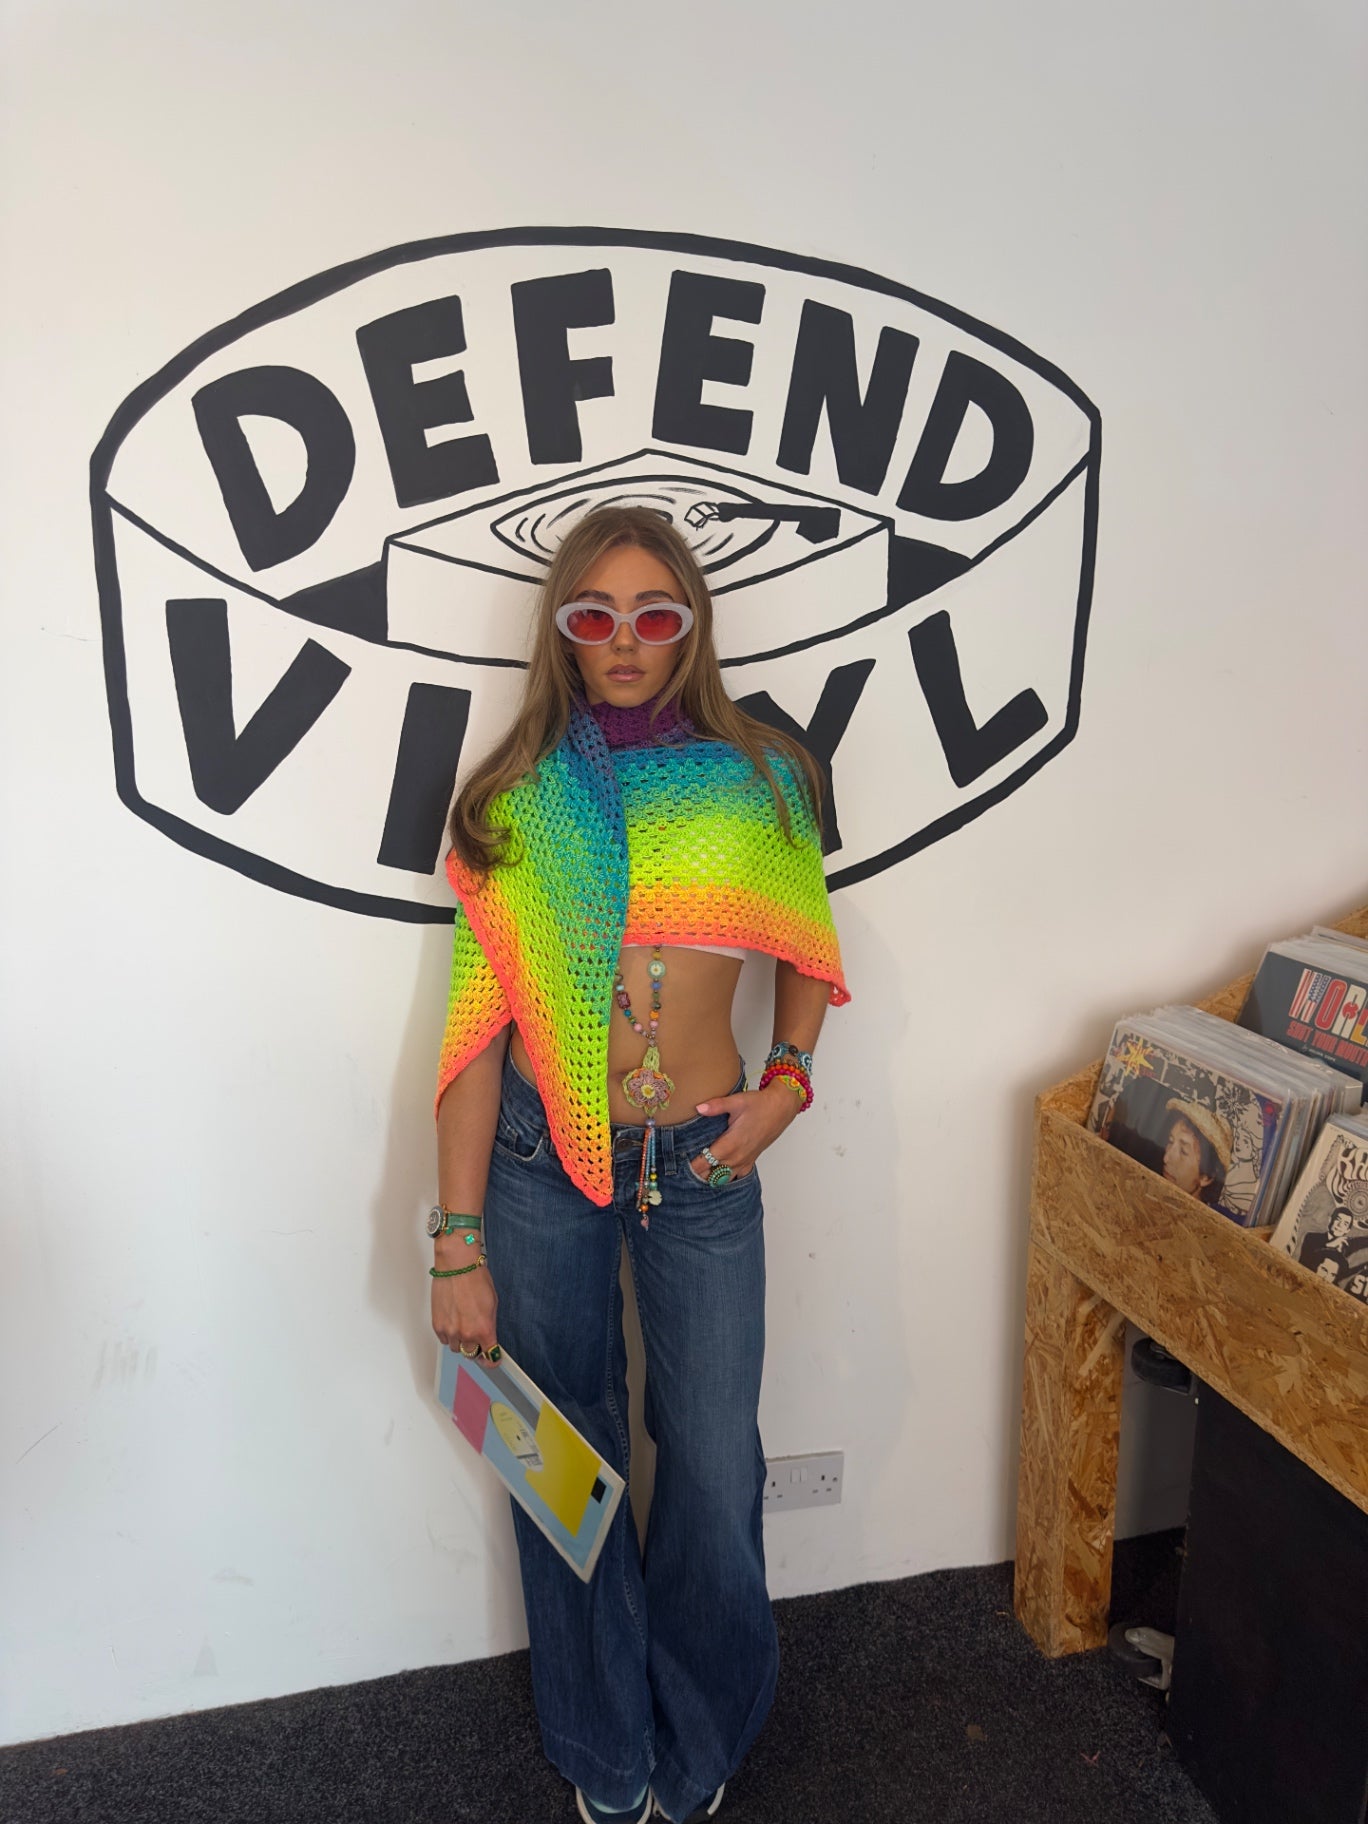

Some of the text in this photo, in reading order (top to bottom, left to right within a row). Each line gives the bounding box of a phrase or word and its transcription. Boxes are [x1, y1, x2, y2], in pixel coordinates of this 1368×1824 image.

[191, 268, 1034, 572] DEFEND
[165, 598, 1049, 875] VIYL
[1288, 968, 1368, 1047] WORL
